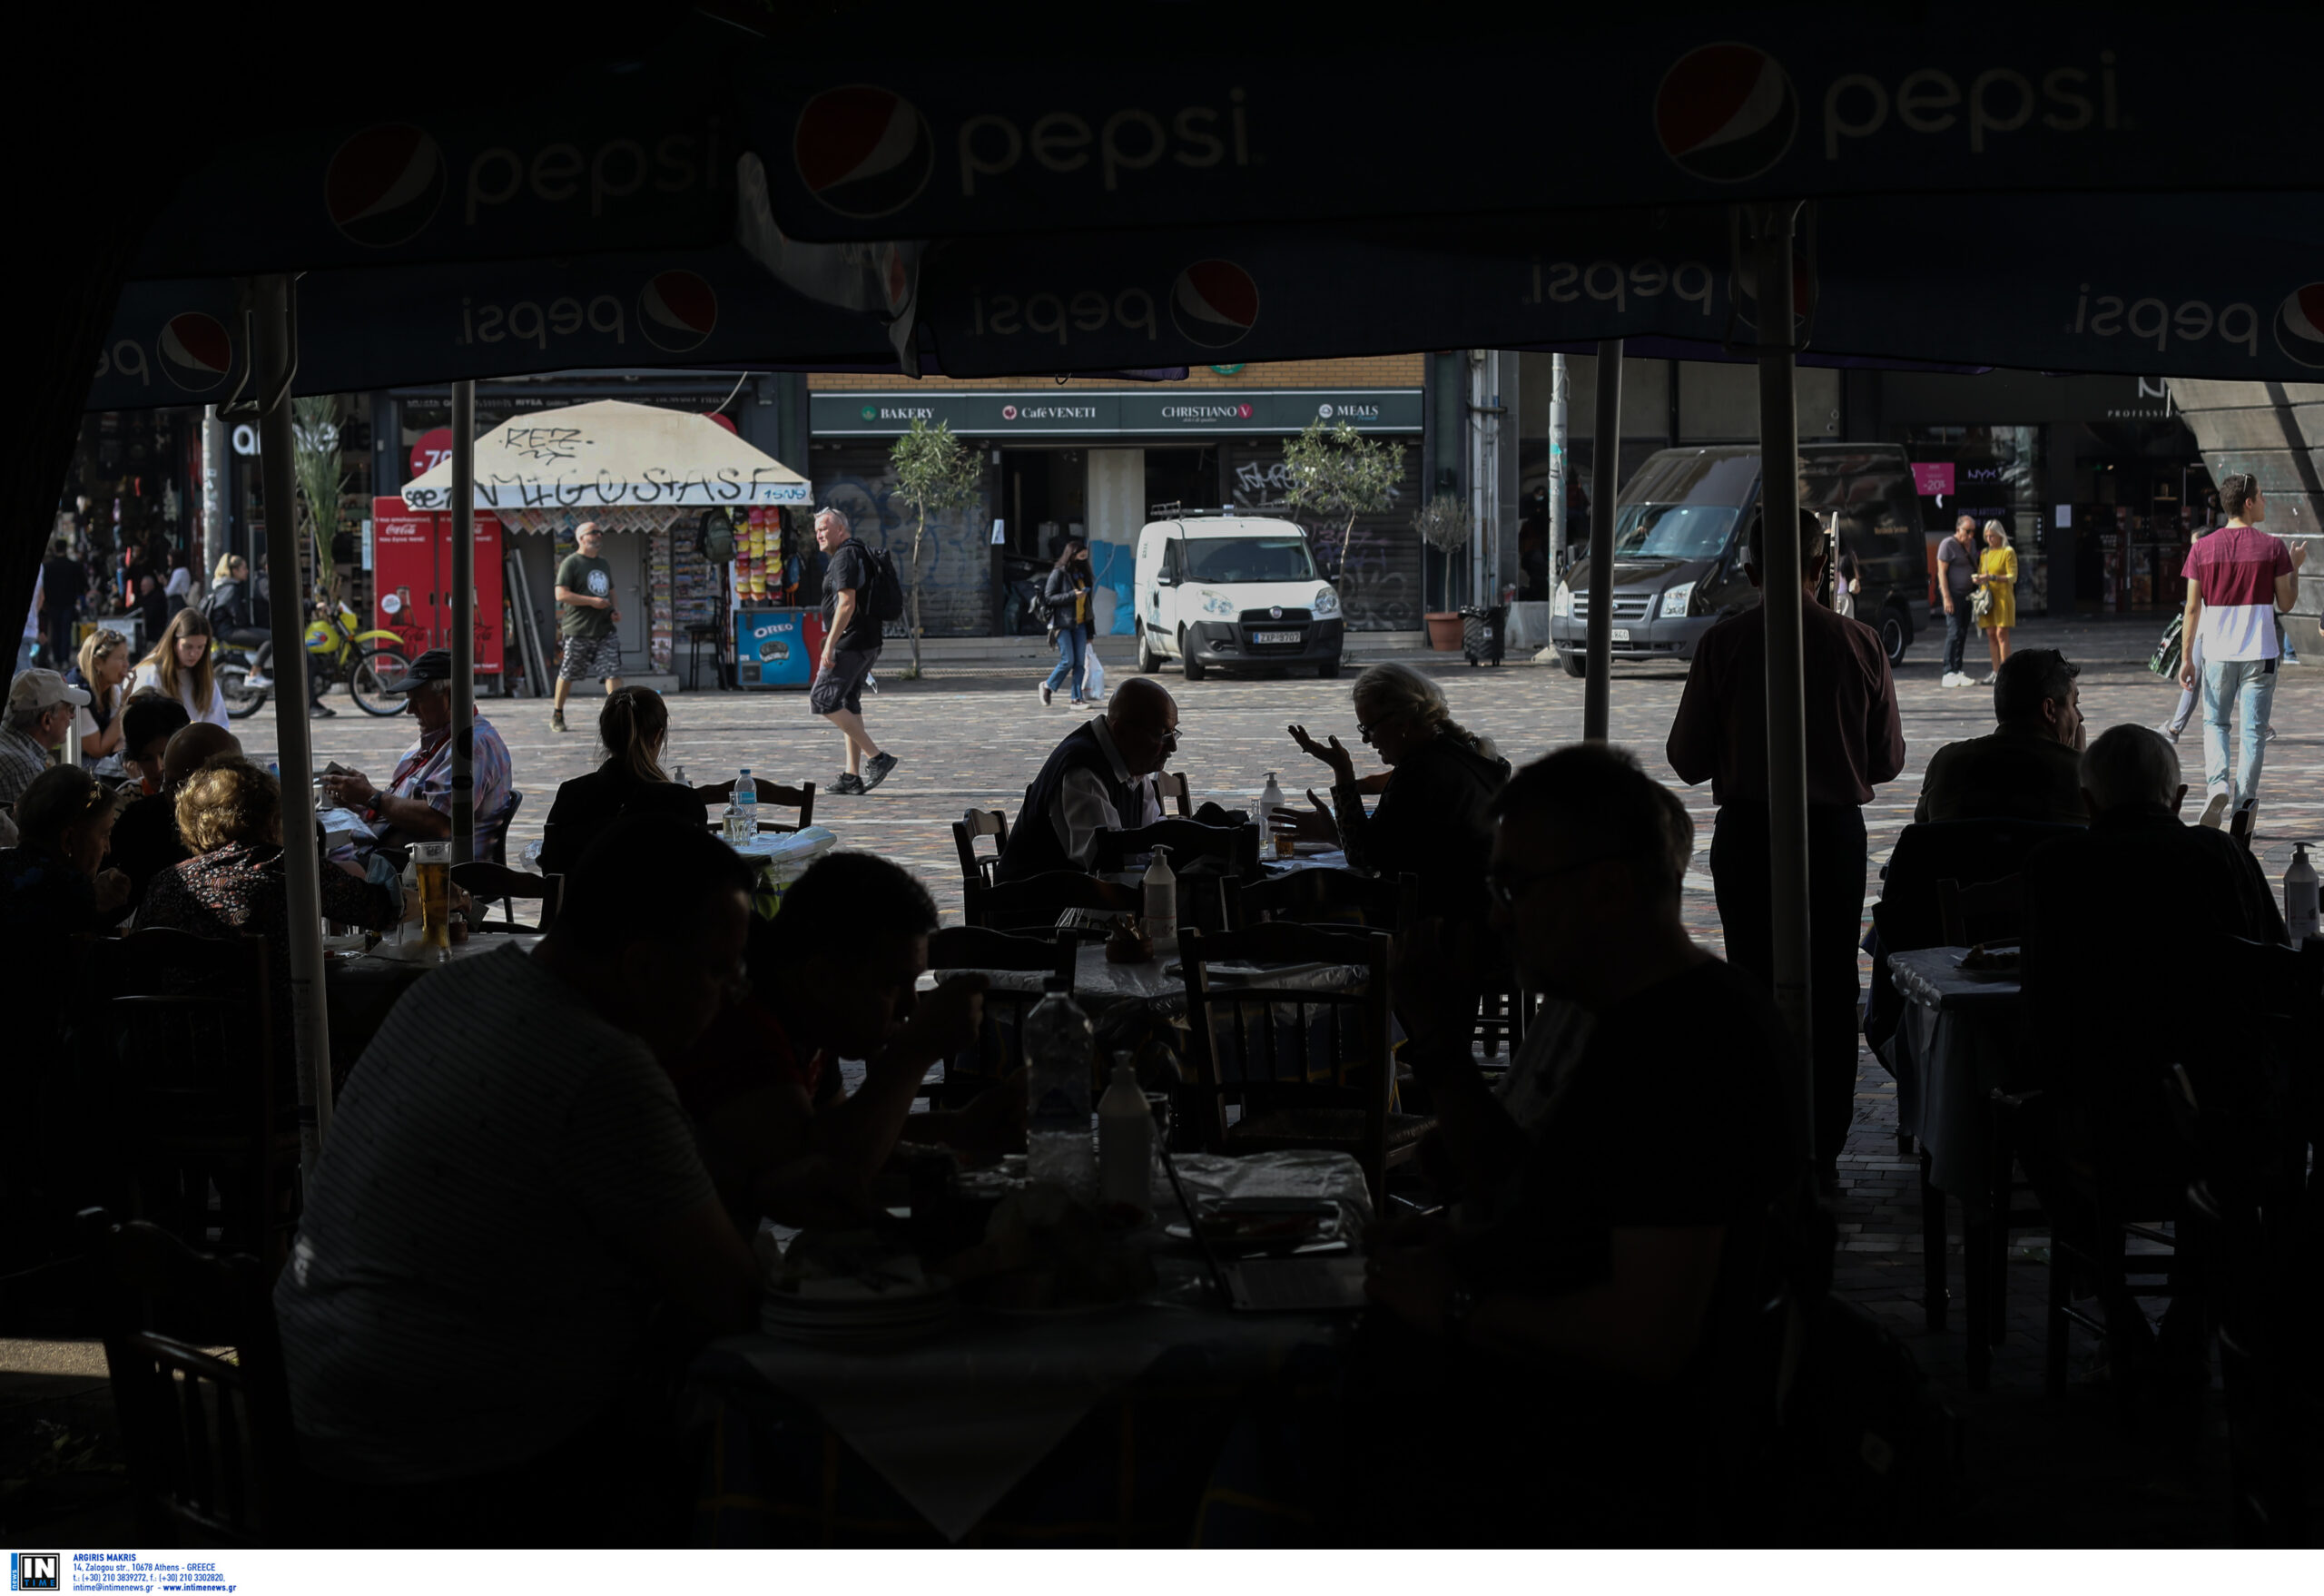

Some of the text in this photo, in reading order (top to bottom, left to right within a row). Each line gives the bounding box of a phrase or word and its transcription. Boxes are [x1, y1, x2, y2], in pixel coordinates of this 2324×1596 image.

[1823, 48, 2119, 161] pepsi
[958, 86, 1249, 196] pepsi
[464, 115, 722, 226] pepsi
[881, 408, 935, 419] BAKERY
[1048, 407, 1096, 419] VENETI
[1161, 406, 1237, 419] CHRISTIANO
[1337, 405, 1379, 417] MEALS
[753, 623, 794, 639] OREO
